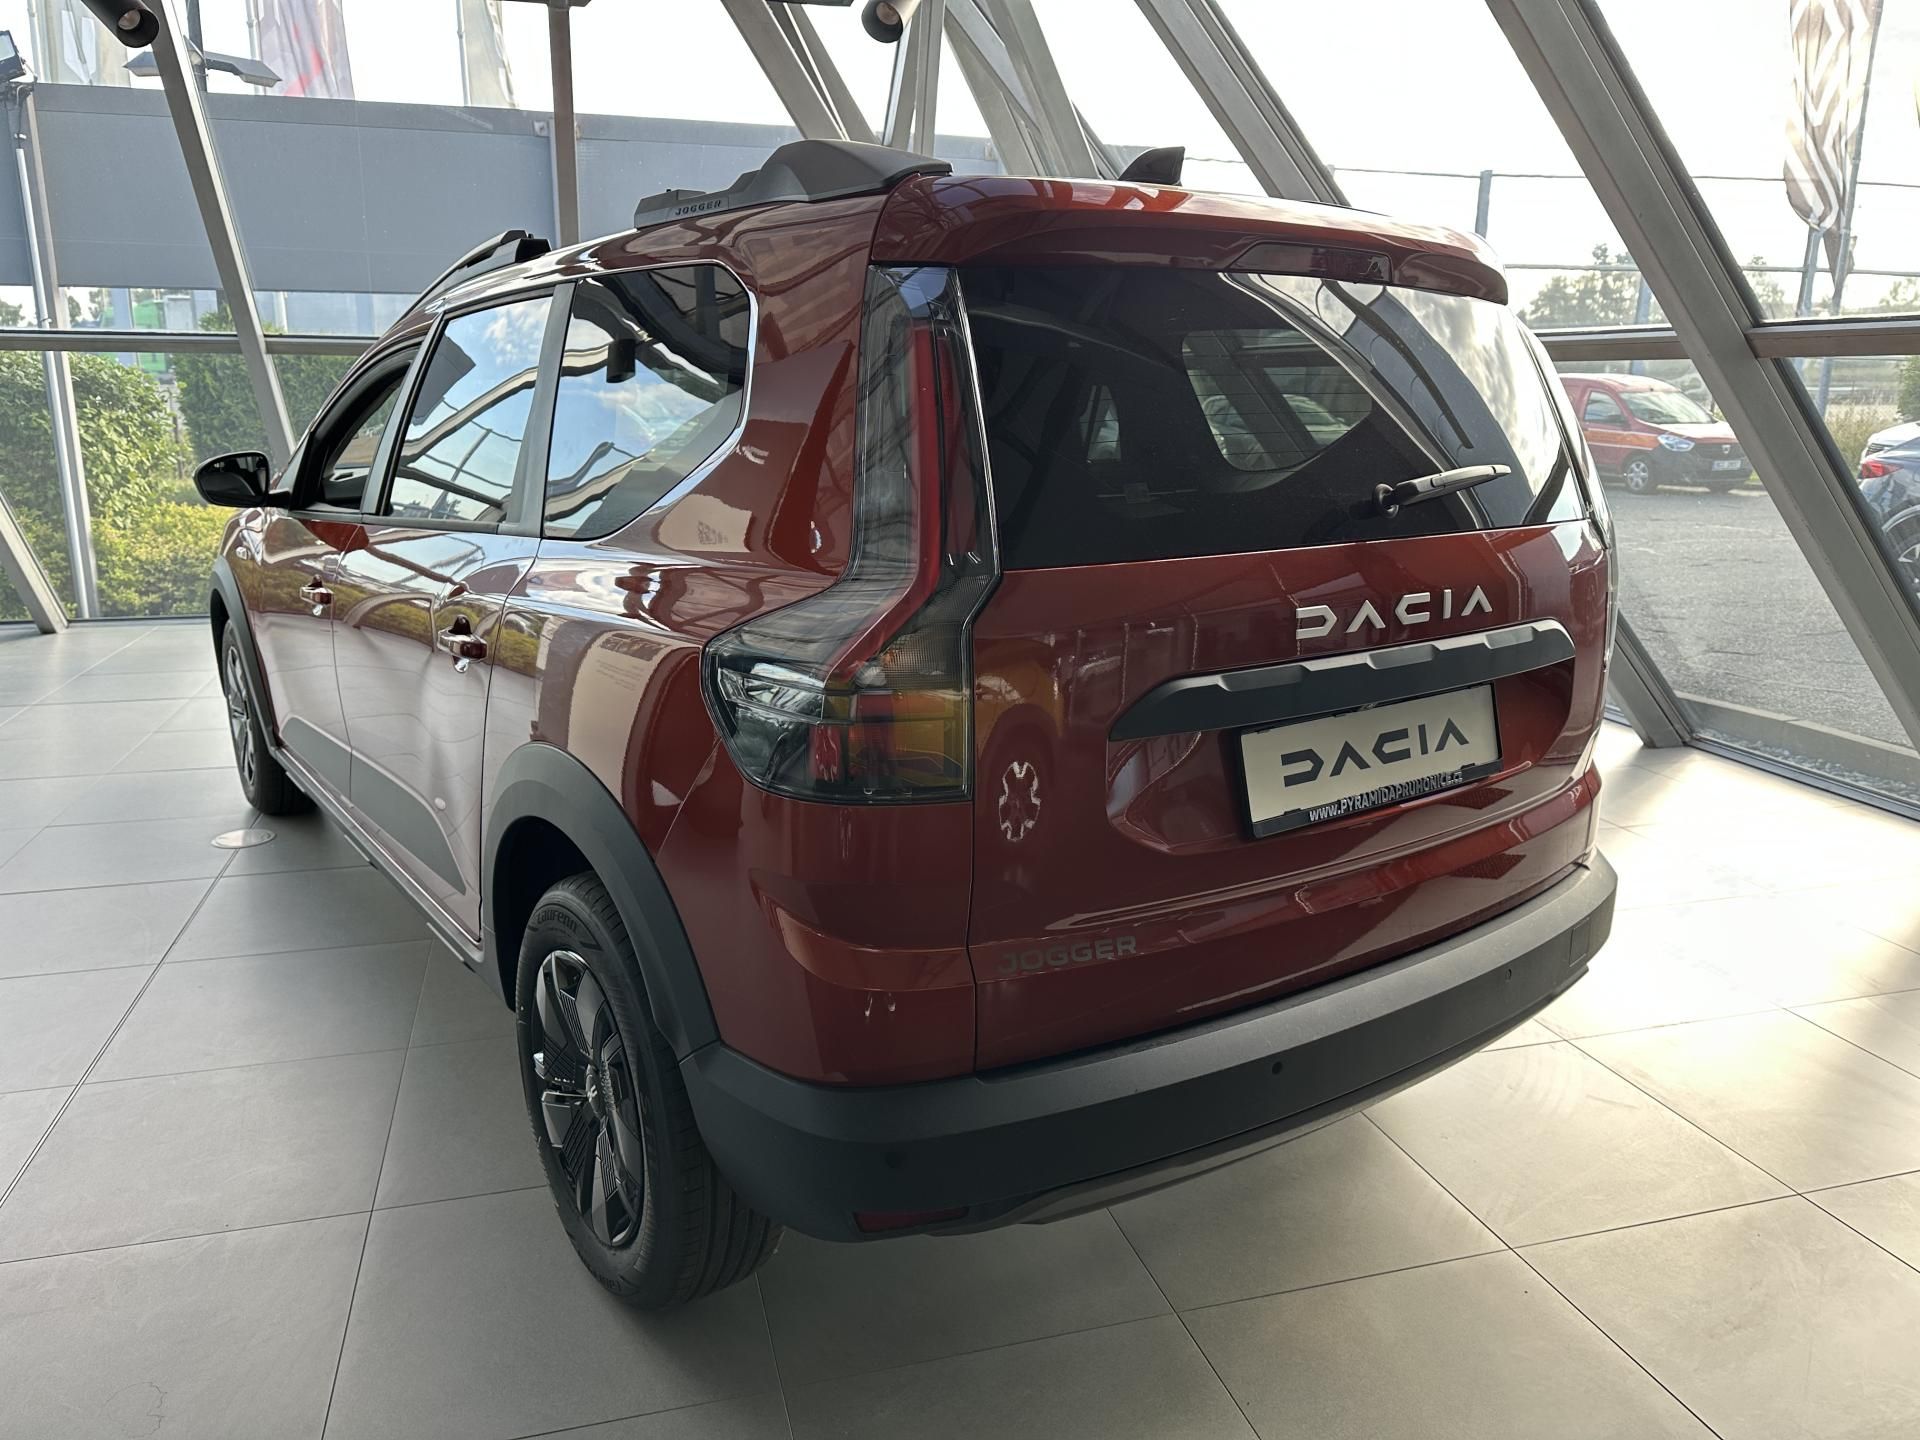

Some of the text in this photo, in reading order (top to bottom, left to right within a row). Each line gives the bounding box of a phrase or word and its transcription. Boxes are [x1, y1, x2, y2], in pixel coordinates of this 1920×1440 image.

[674, 199, 721, 216] JOGGER
[1296, 585, 1493, 639] DACIA
[1280, 718, 1469, 787] DACIA
[997, 935, 1136, 973] JOGGER
